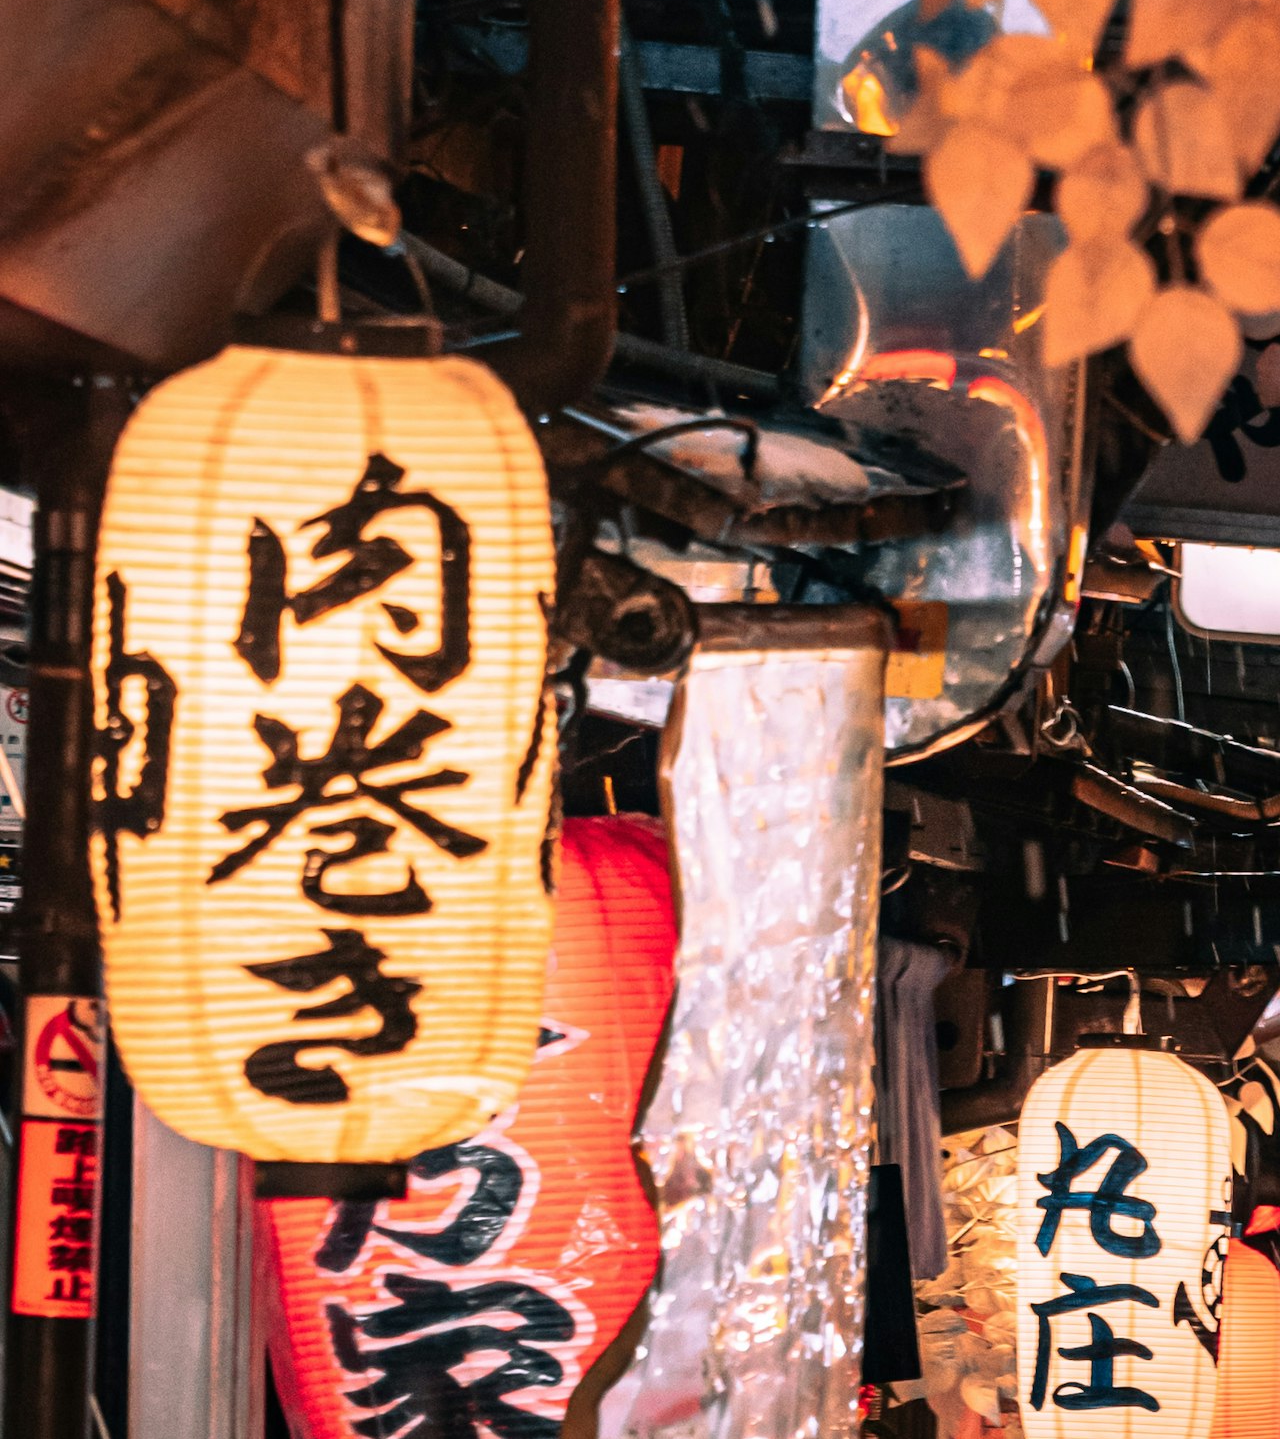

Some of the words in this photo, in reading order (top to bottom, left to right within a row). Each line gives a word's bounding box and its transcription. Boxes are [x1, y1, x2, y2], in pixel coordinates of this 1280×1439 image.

[205, 451, 490, 1106] 肉巻き
[1029, 1121, 1162, 1412] 丸庄
